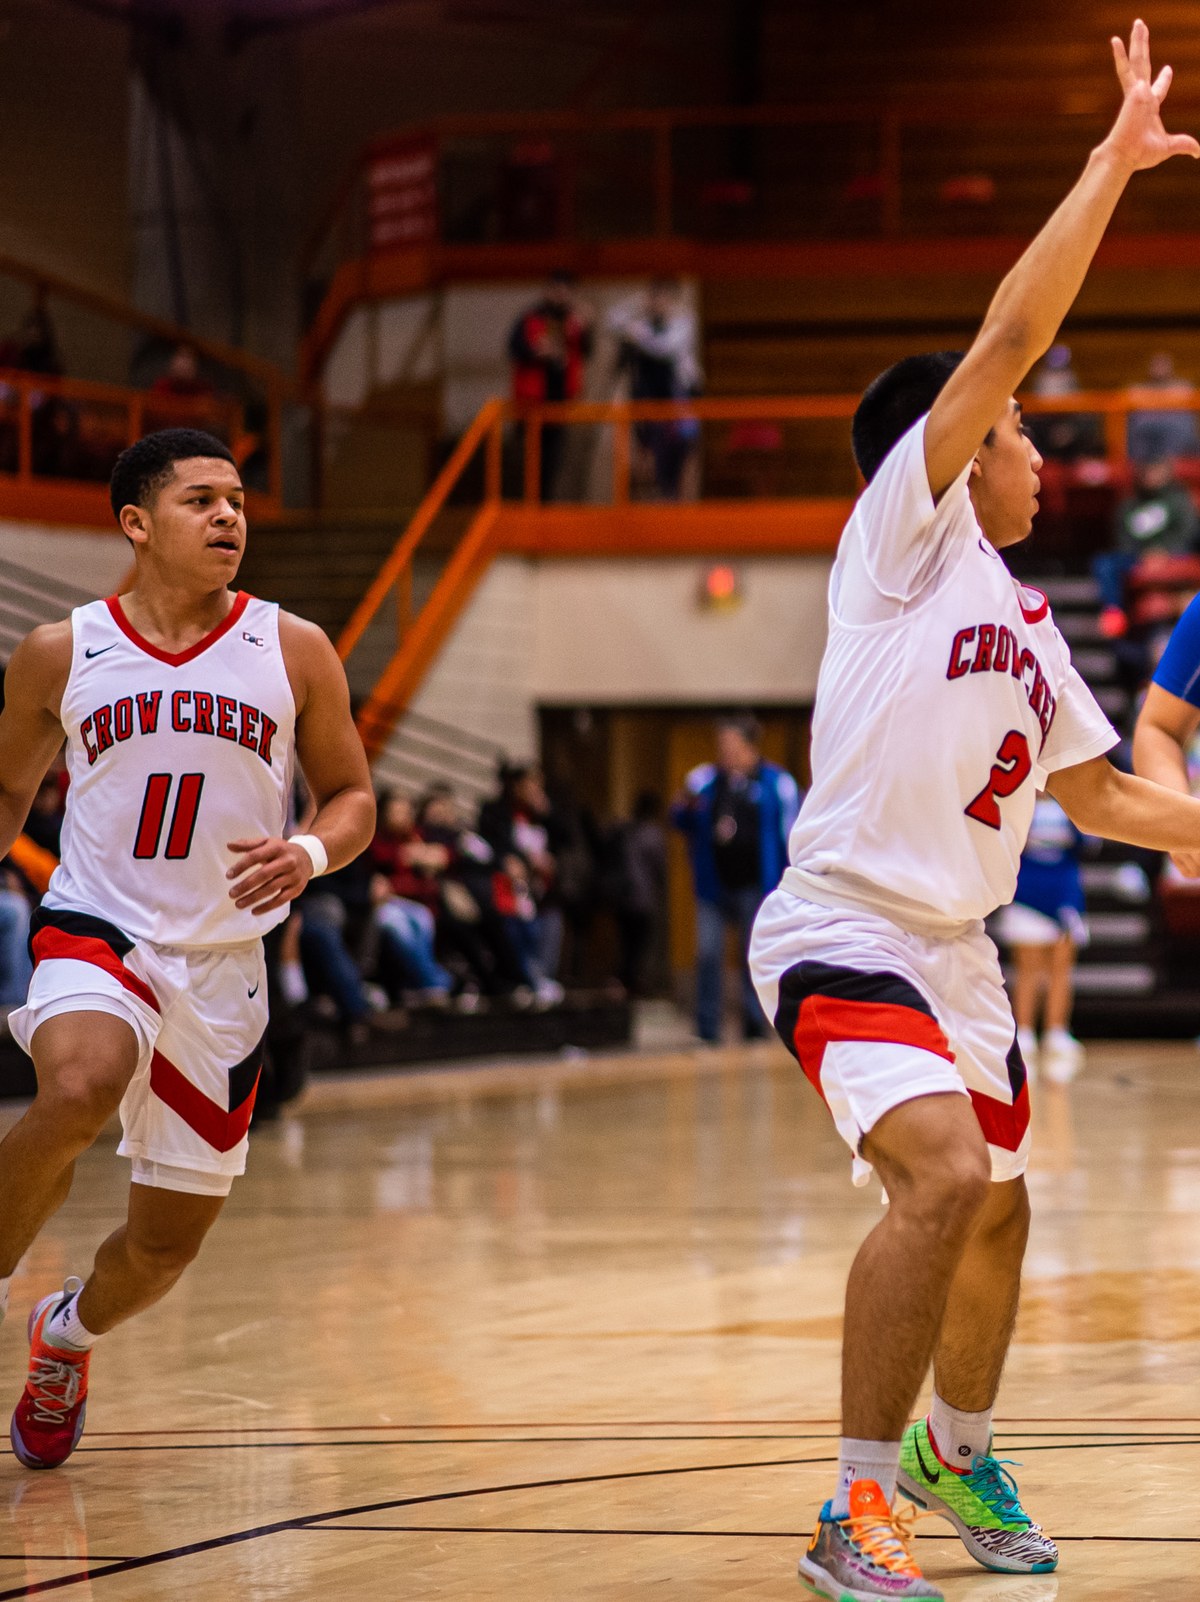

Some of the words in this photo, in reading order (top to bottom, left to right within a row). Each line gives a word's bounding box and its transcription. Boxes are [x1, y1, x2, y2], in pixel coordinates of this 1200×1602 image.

[80, 690, 163, 766] CROW
[171, 690, 278, 767] CREEK
[133, 772, 205, 860] 11
[964, 729, 1032, 832] 2
